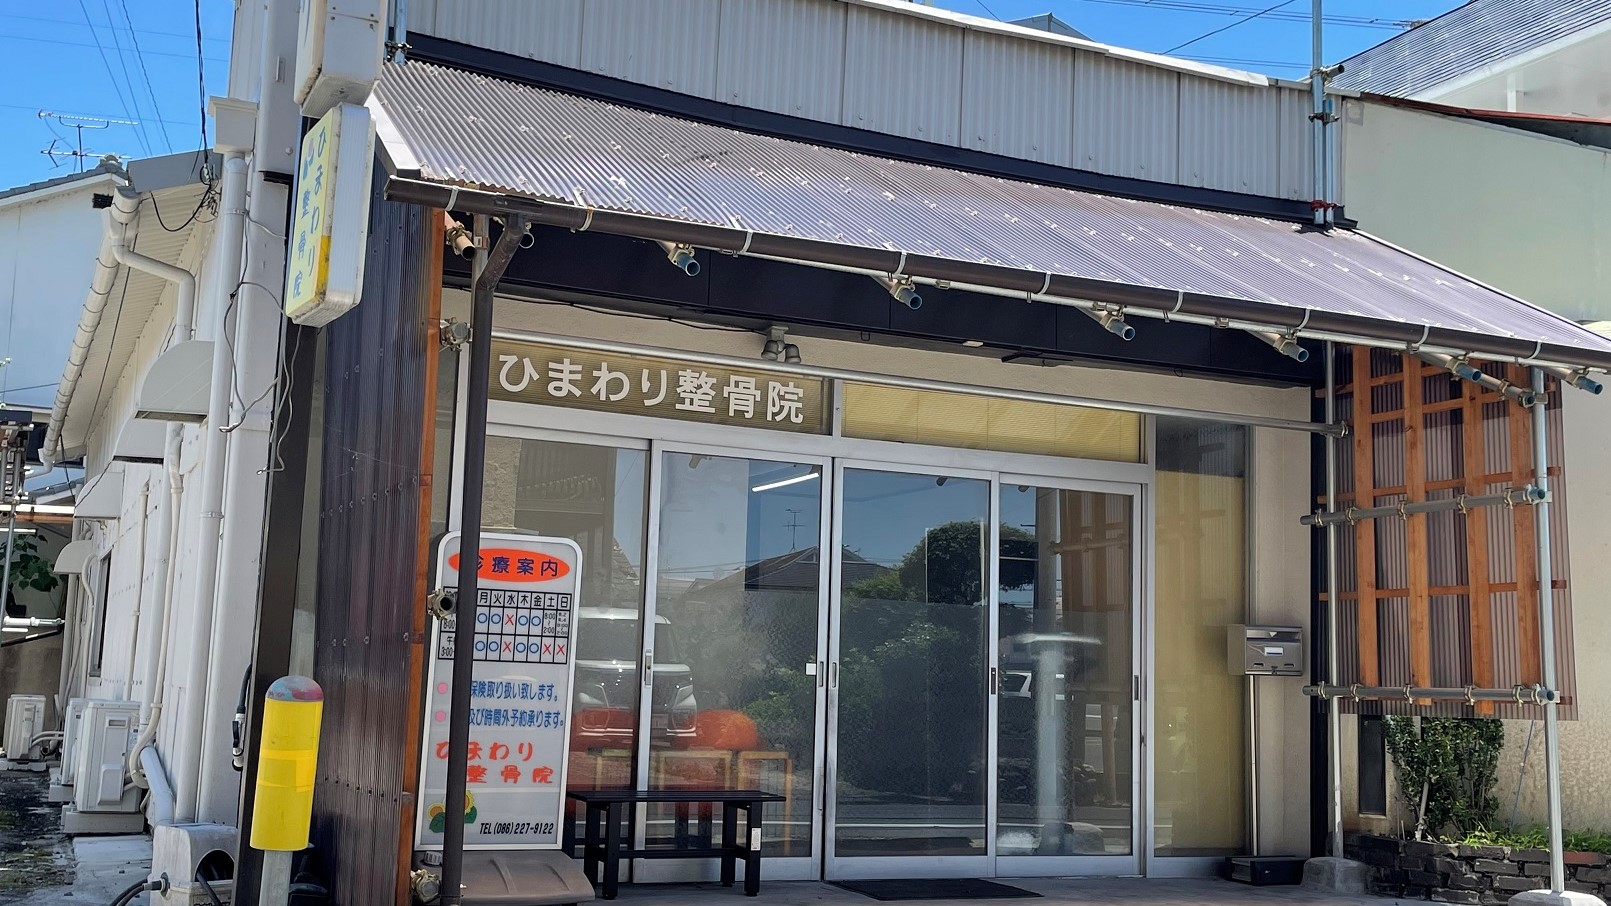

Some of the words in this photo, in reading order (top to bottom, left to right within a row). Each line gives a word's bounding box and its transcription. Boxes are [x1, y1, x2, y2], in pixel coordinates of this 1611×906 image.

[307, 126, 327, 277] ひまわり
[293, 188, 309, 299] 整骨院
[498, 354, 804, 424] ひまわり整骨院
[479, 592, 489, 604] 月
[493, 593, 503, 605] 火
[506, 594, 516, 606] 水
[520, 594, 529, 606] 木
[533, 595, 542, 607] 金
[546, 596, 555, 607] 土
[560, 596, 569, 608] 日
[447, 636, 456, 646] 午
[441, 646, 455, 657] 3:00
[479, 822, 492, 835] TEL
